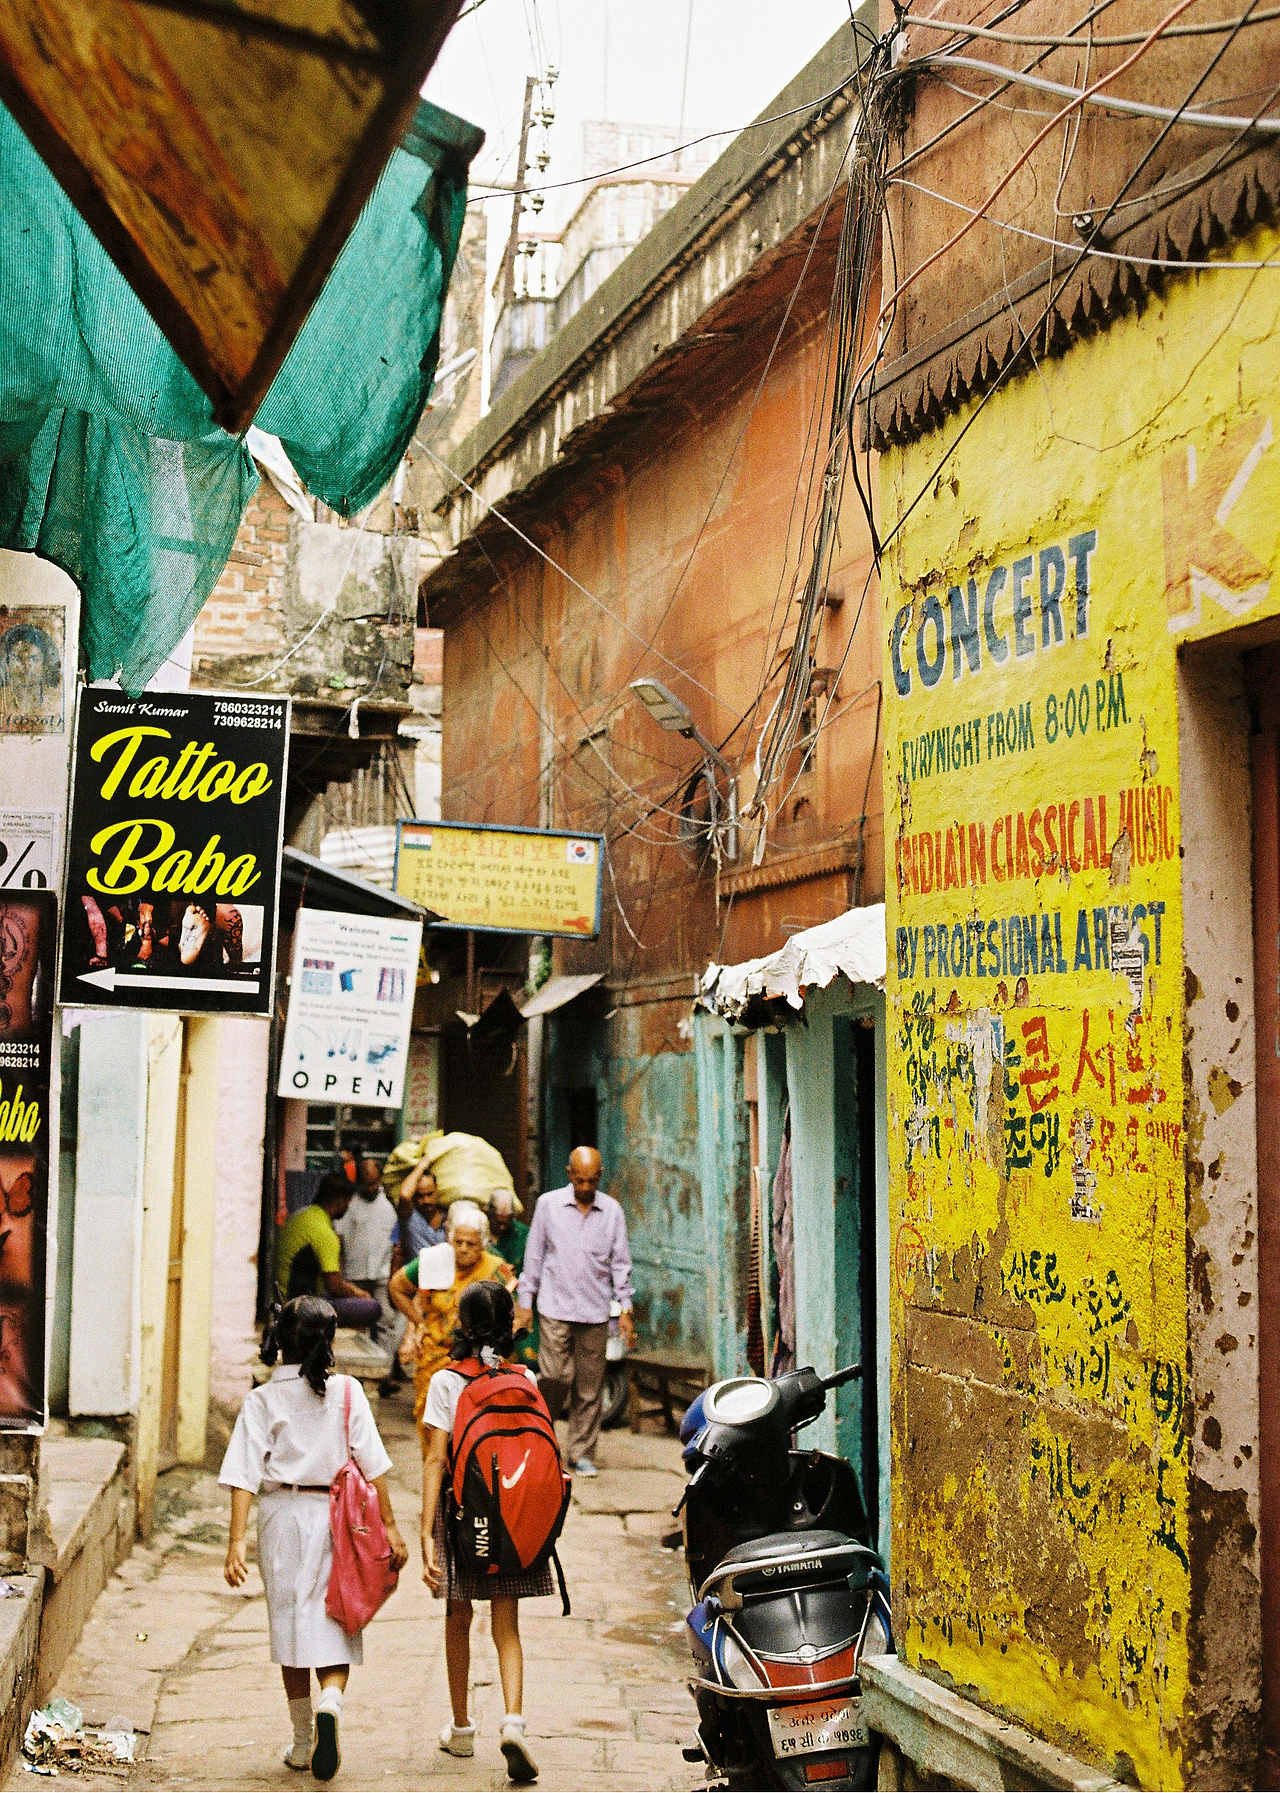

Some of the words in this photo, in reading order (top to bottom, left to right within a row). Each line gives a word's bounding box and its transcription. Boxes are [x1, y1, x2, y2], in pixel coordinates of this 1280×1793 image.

[891, 529, 1099, 699] CONCERT
[93, 700, 135, 715] Sumit
[138, 703, 189, 718] Kumar
[213, 702, 283, 716] 7860323214
[213, 715, 282, 729] 7309628214
[987, 702, 1034, 760] FROM
[1046, 683, 1089, 744] 8:00
[90, 726, 272, 804] Tattoo
[86, 818, 262, 896] Baba
[896, 925, 919, 980] BY
[923, 911, 1068, 979] PROFESIONAL
[0, 1077, 41, 1143] aba
[292, 1071, 393, 1098] OPEN
[474, 1516, 489, 1557] NIKE
[777, 1559, 823, 1574] YAMAHA
